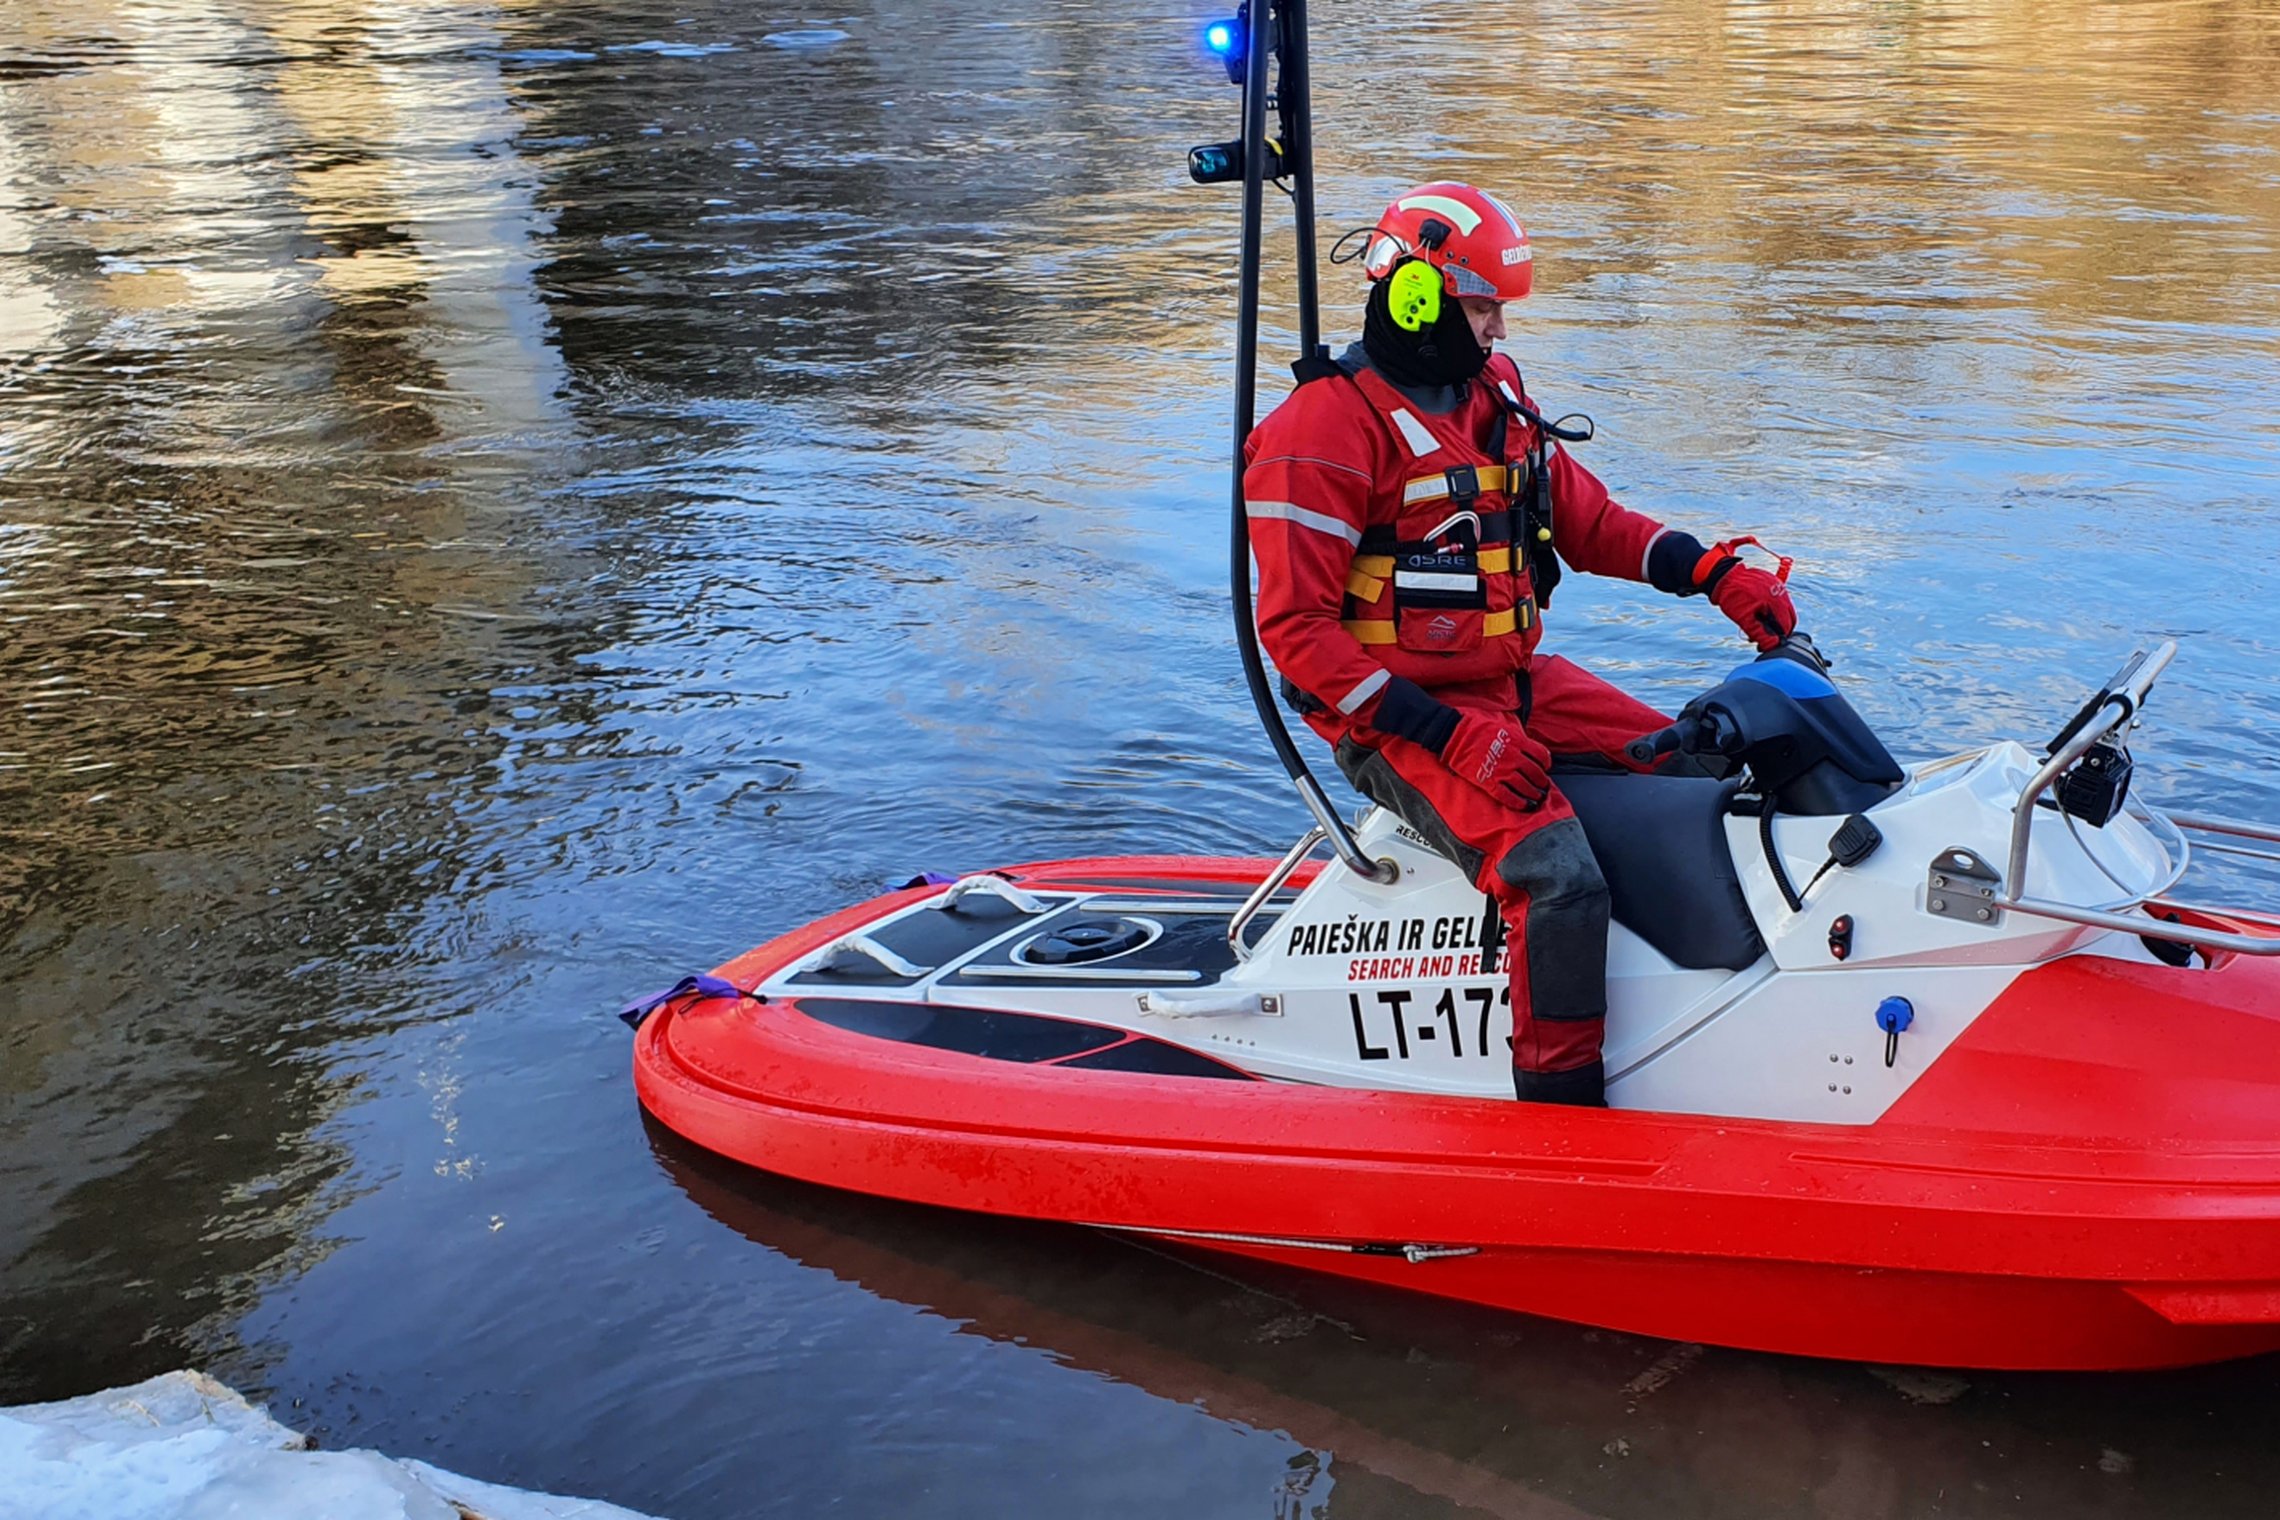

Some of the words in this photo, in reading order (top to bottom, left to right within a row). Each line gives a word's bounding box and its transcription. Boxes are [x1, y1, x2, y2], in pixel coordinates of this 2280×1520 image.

[1287, 914, 1390, 956] PAIEŠKA
[1398, 919, 1425, 951] IR
[1348, 957, 1414, 981] SEARCH
[1418, 954, 1453, 979] AND
